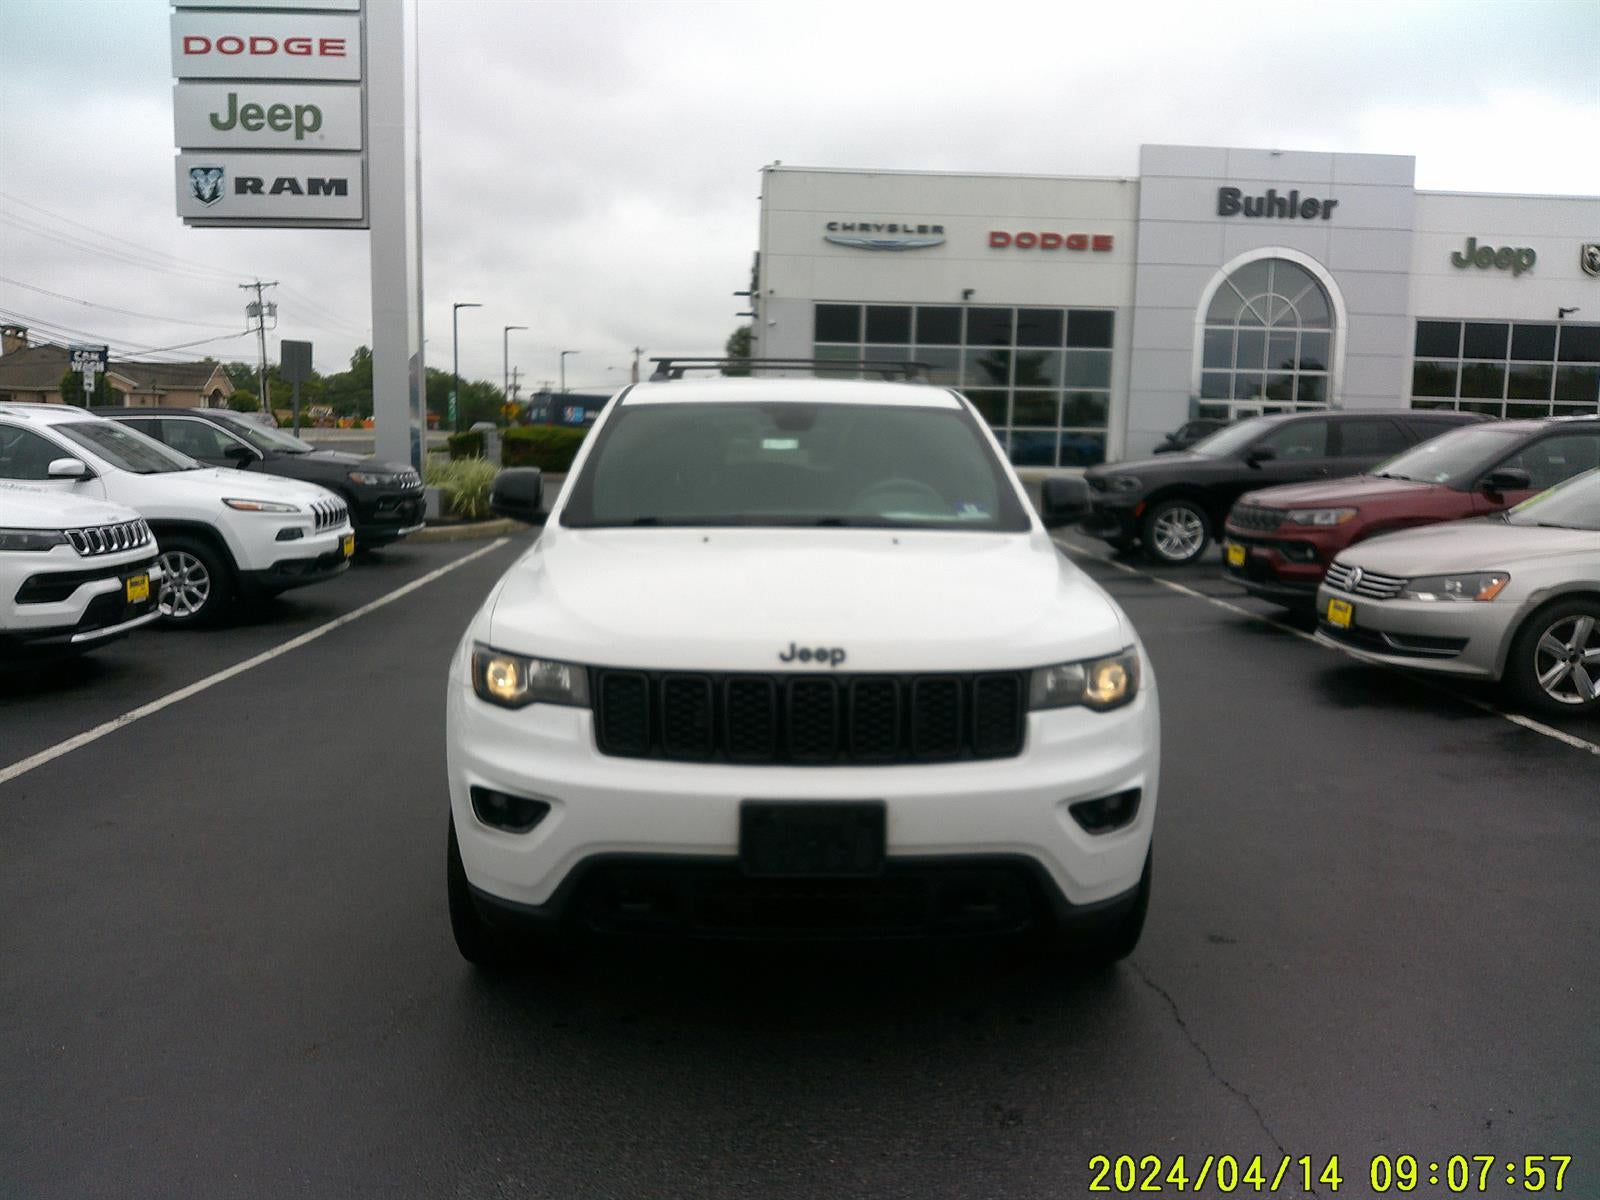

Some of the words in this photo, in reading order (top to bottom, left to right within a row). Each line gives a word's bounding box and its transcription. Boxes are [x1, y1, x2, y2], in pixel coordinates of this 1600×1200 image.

[183, 36, 346, 56] DODGE
[209, 93, 322, 140] Jeep
[234, 176, 348, 196] RAM
[1216, 186, 1338, 220] Buhler
[826, 221, 944, 234] CHRYSLER
[988, 231, 1114, 252] DODGE
[1451, 237, 1537, 277] Jeep
[779, 643, 846, 667] Jeep
